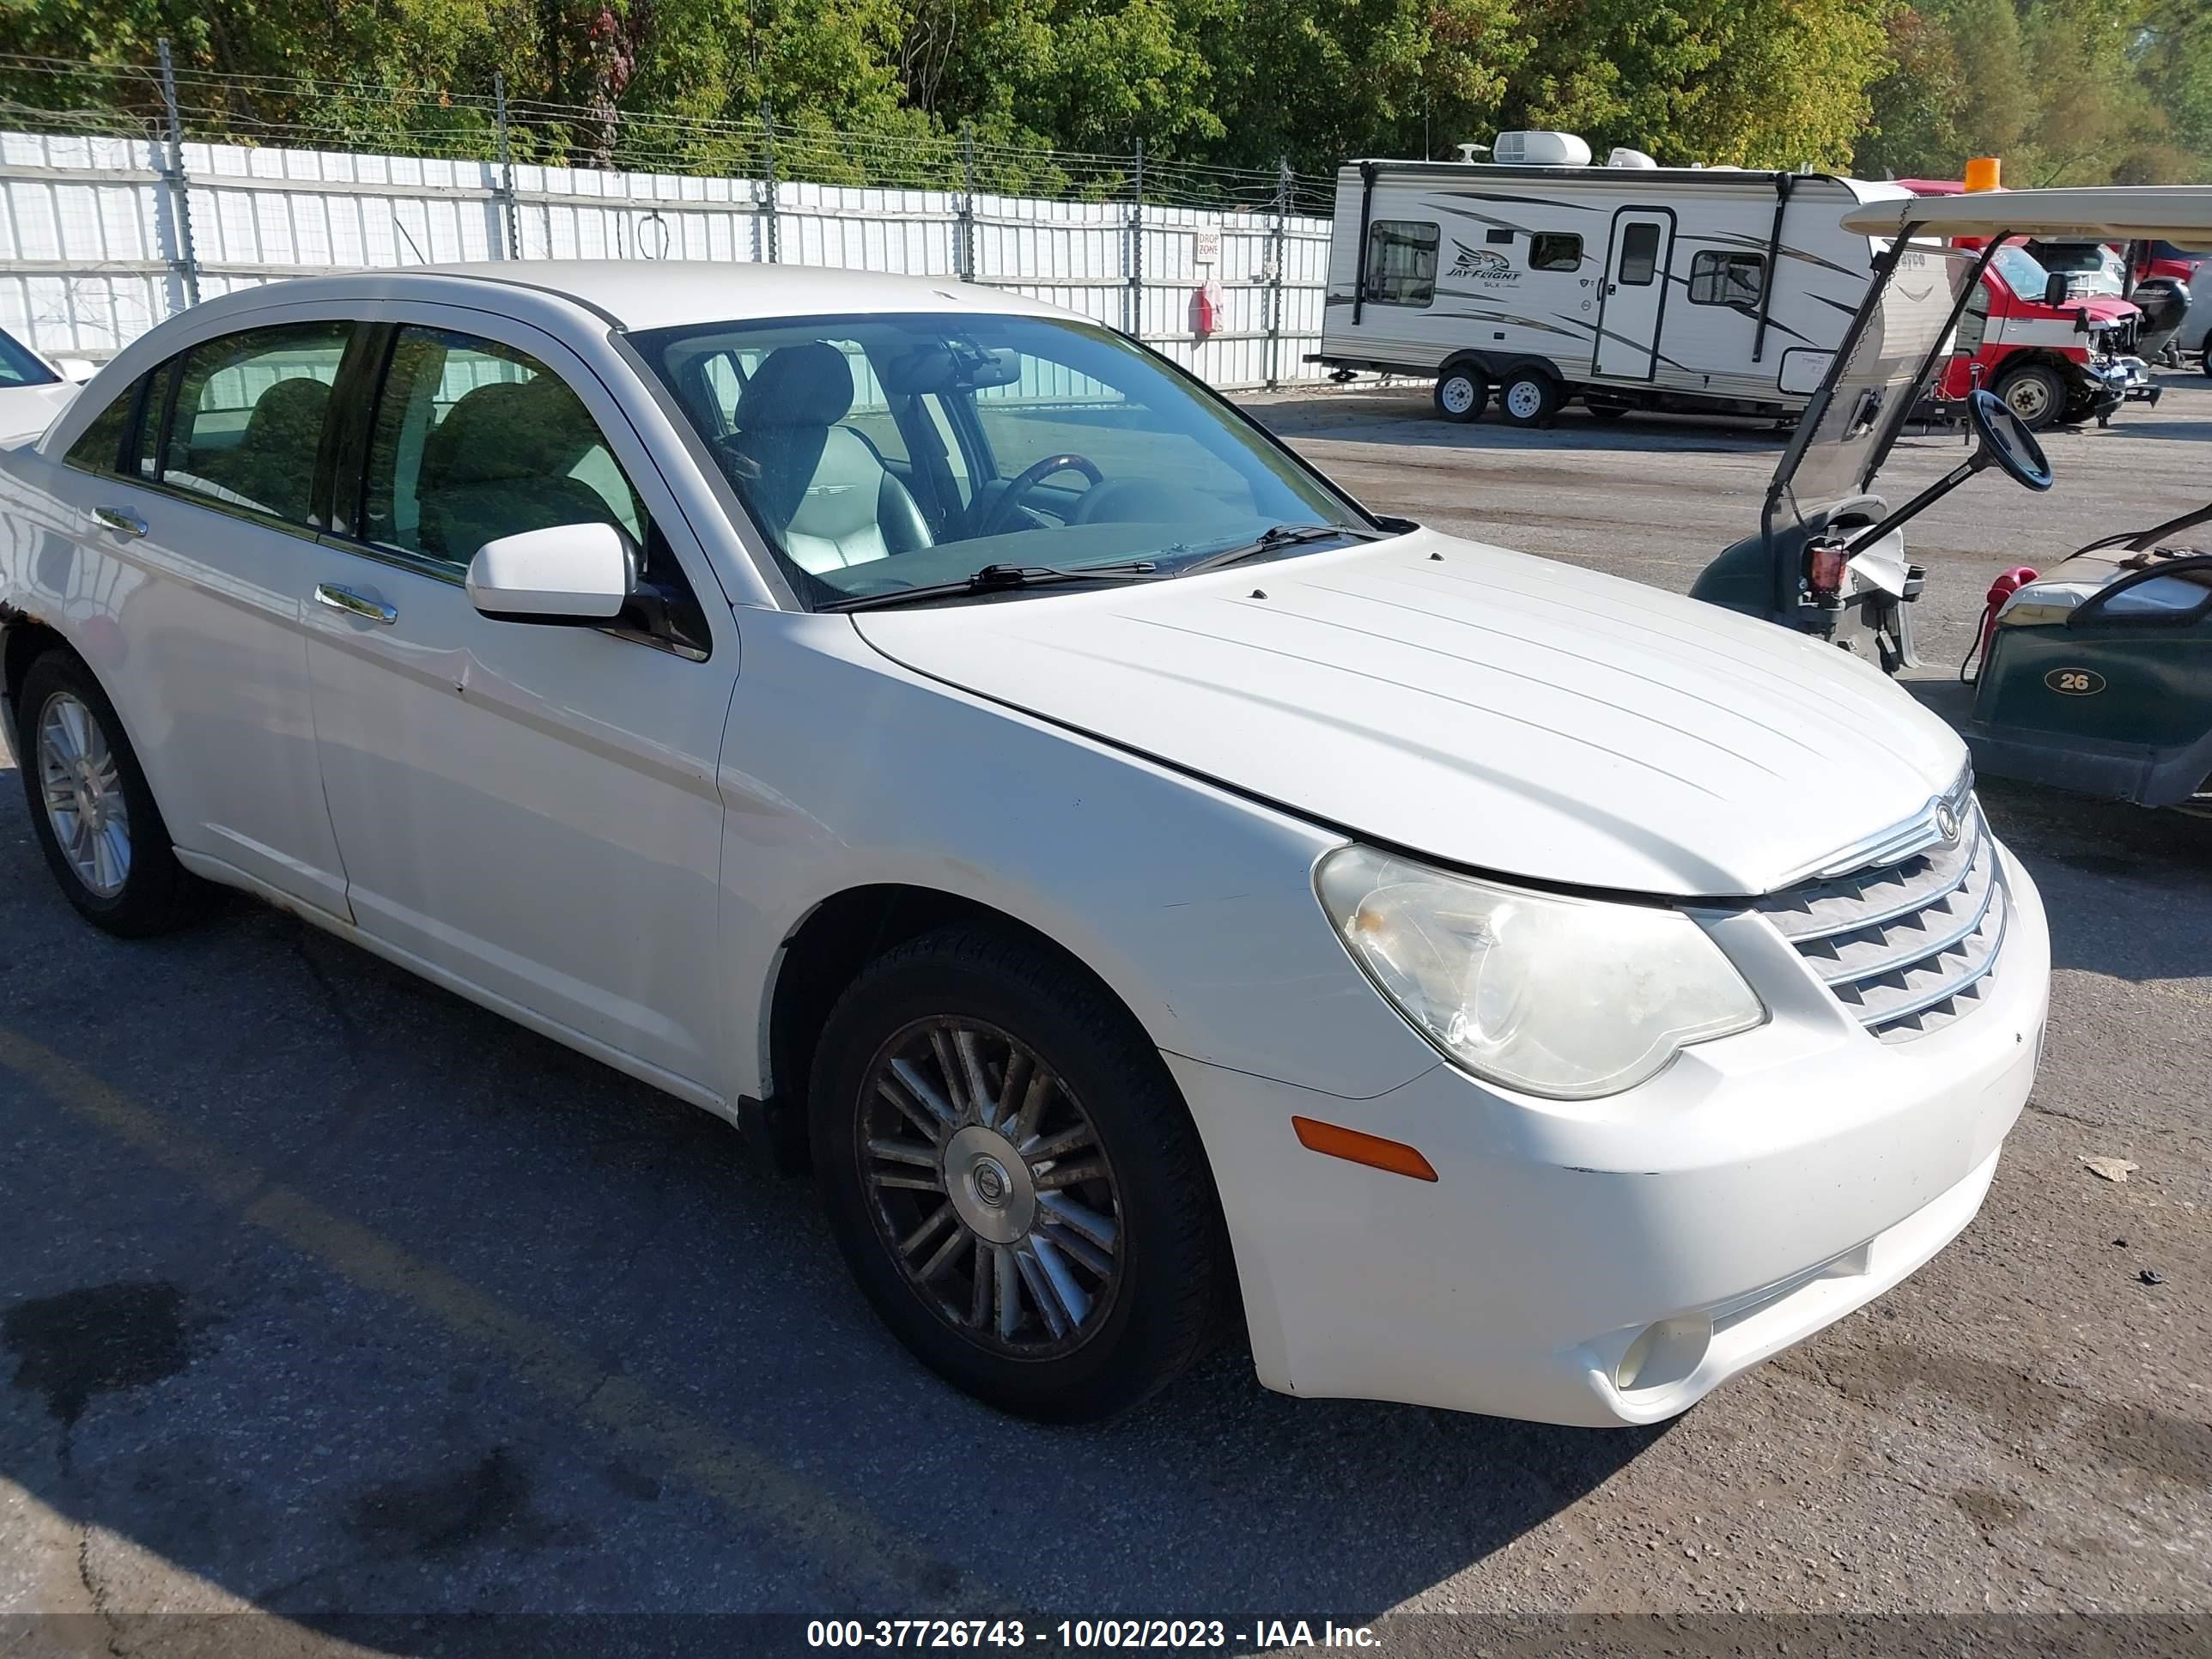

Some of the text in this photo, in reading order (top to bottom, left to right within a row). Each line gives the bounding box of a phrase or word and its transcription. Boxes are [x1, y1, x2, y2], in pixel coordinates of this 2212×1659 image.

[1199, 234, 1219, 244] DROP
[1199, 246, 1218, 255] ZONE
[1901, 252, 1925, 271] ayco
[1445, 268, 1522, 281] JAY FLIGHT
[2061, 673, 2089, 690] 26
